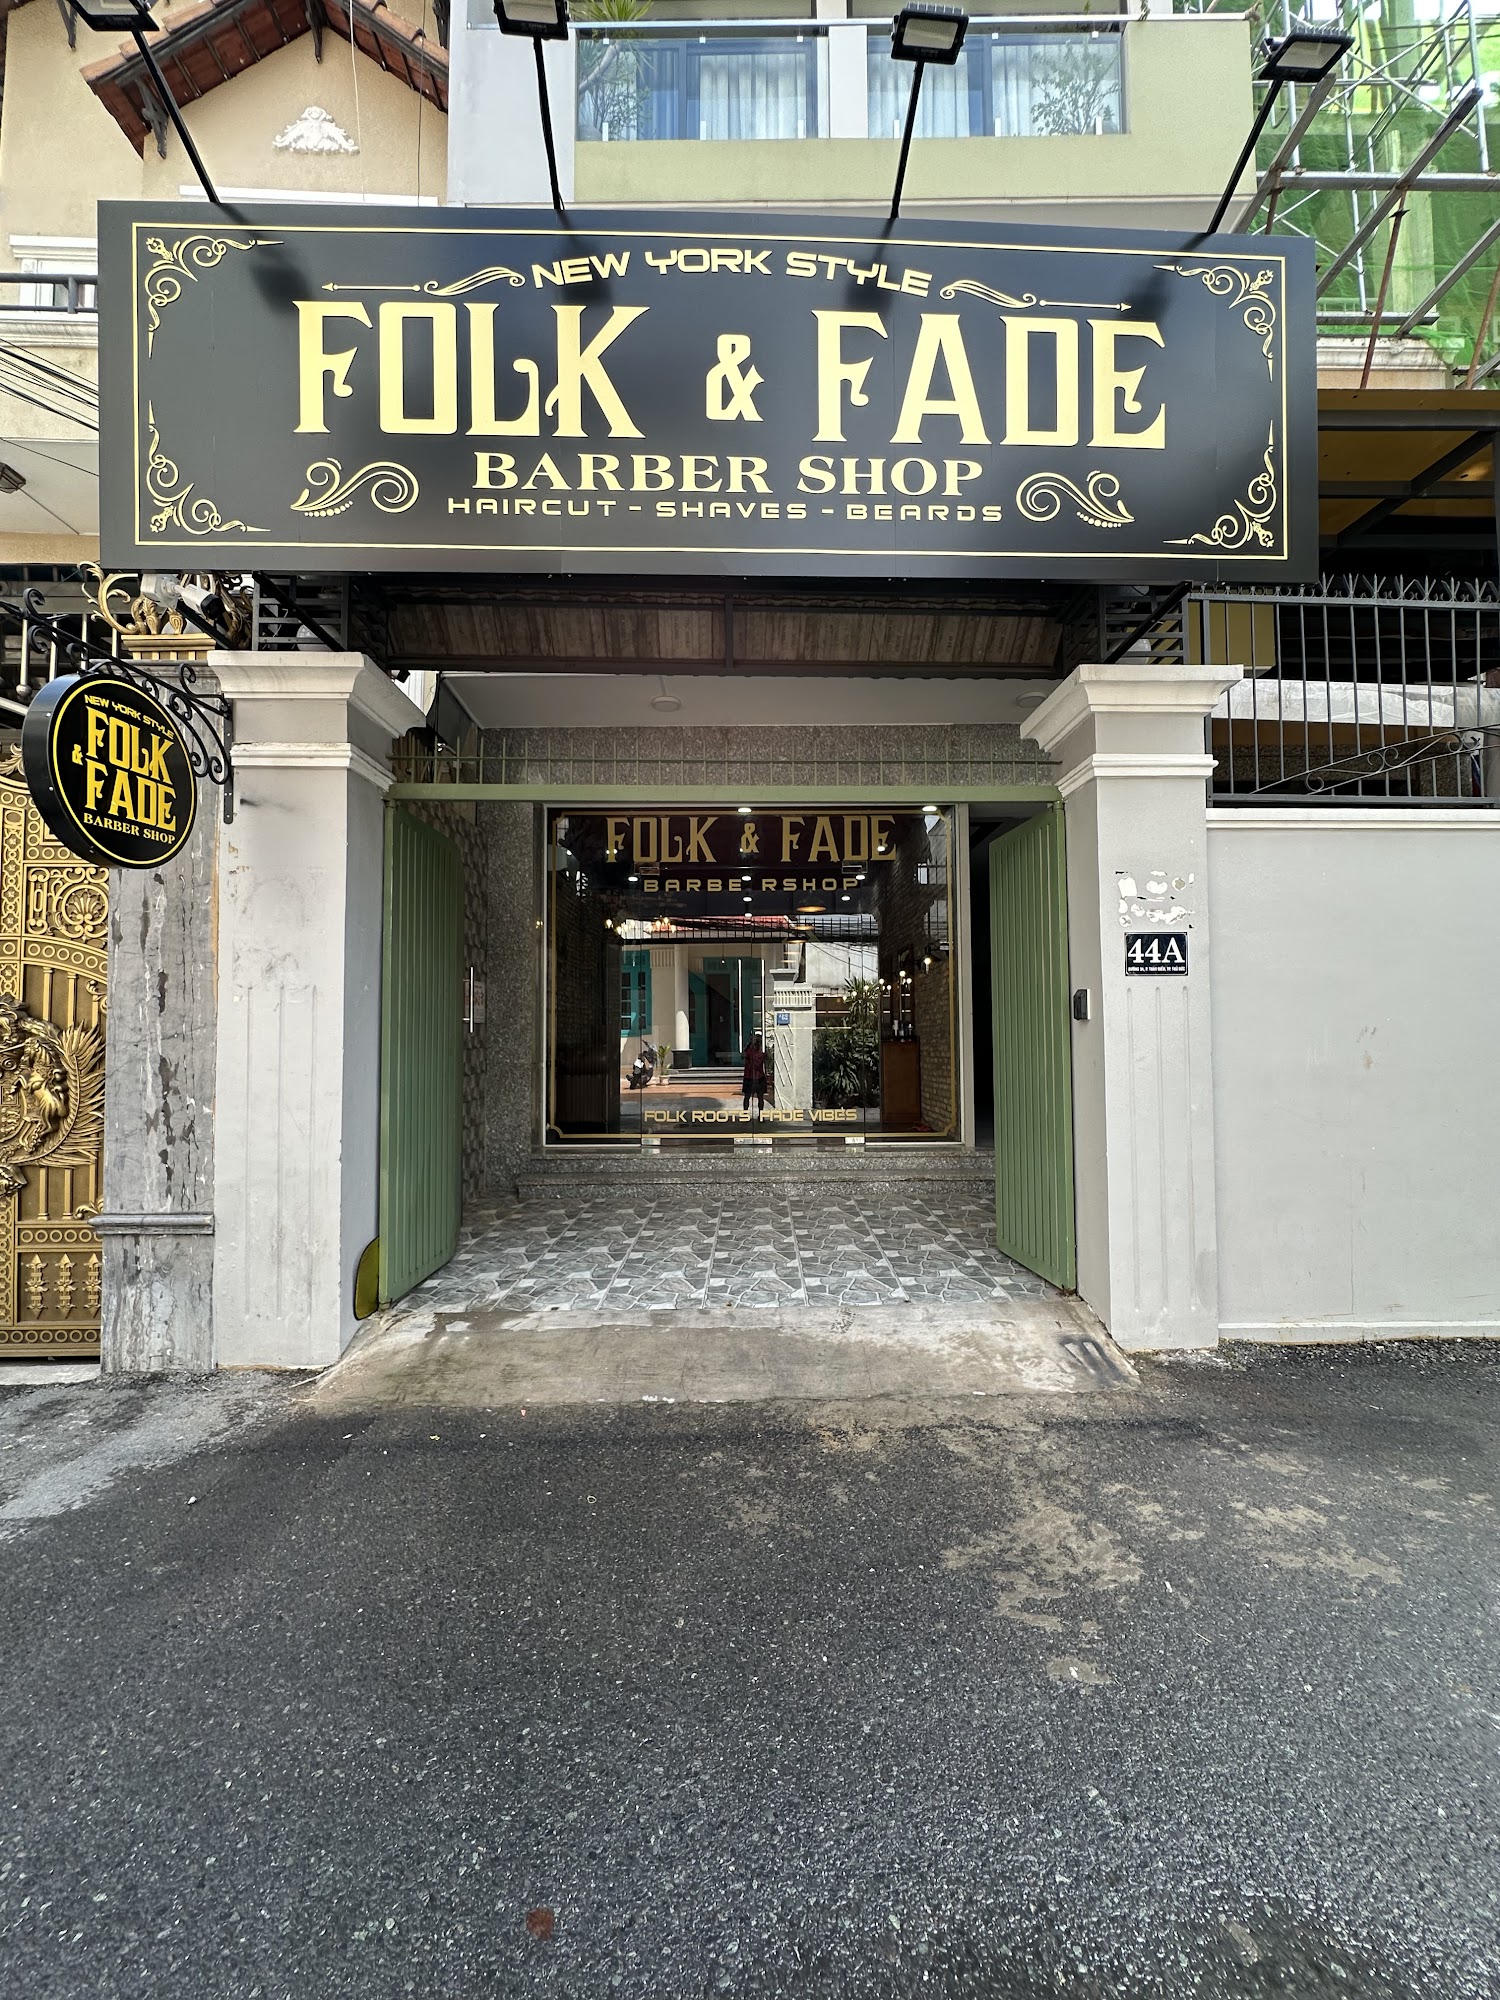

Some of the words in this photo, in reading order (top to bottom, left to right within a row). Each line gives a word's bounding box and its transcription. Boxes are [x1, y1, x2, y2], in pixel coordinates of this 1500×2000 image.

[532, 252, 629, 287] NEW
[645, 249, 769, 272] YORK
[787, 252, 932, 295] STYLE
[293, 301, 646, 437] FOLK
[706, 334, 762, 421] &
[815, 310, 1165, 448] FADE
[474, 452, 769, 493] BARBER
[799, 456, 982, 495] SHOP
[448, 498, 616, 515] HAIRCUT
[656, 502, 806, 518] SHAVES
[848, 504, 1001, 520] BEARDS
[85, 694, 110, 709] NEW
[111, 701, 142, 720] YORK
[143, 715, 174, 740] STYLE
[72, 744, 83, 765] &
[86, 706, 175, 785] FOLK
[85, 758, 176, 832] FADE
[83, 812, 140, 837] BARBER
[143, 828, 176, 845] SHOP
[606, 817, 718, 863] FOLK
[741, 822, 760, 852] &
[780, 816, 897, 862] FADE
[1128, 937, 1185, 963] 44A
[645, 1110, 687, 1122] FOLK
[692, 1109, 751, 1122] ROOTS
[760, 1109, 805, 1122] FADE
[809, 1109, 858, 1122] VIBES
